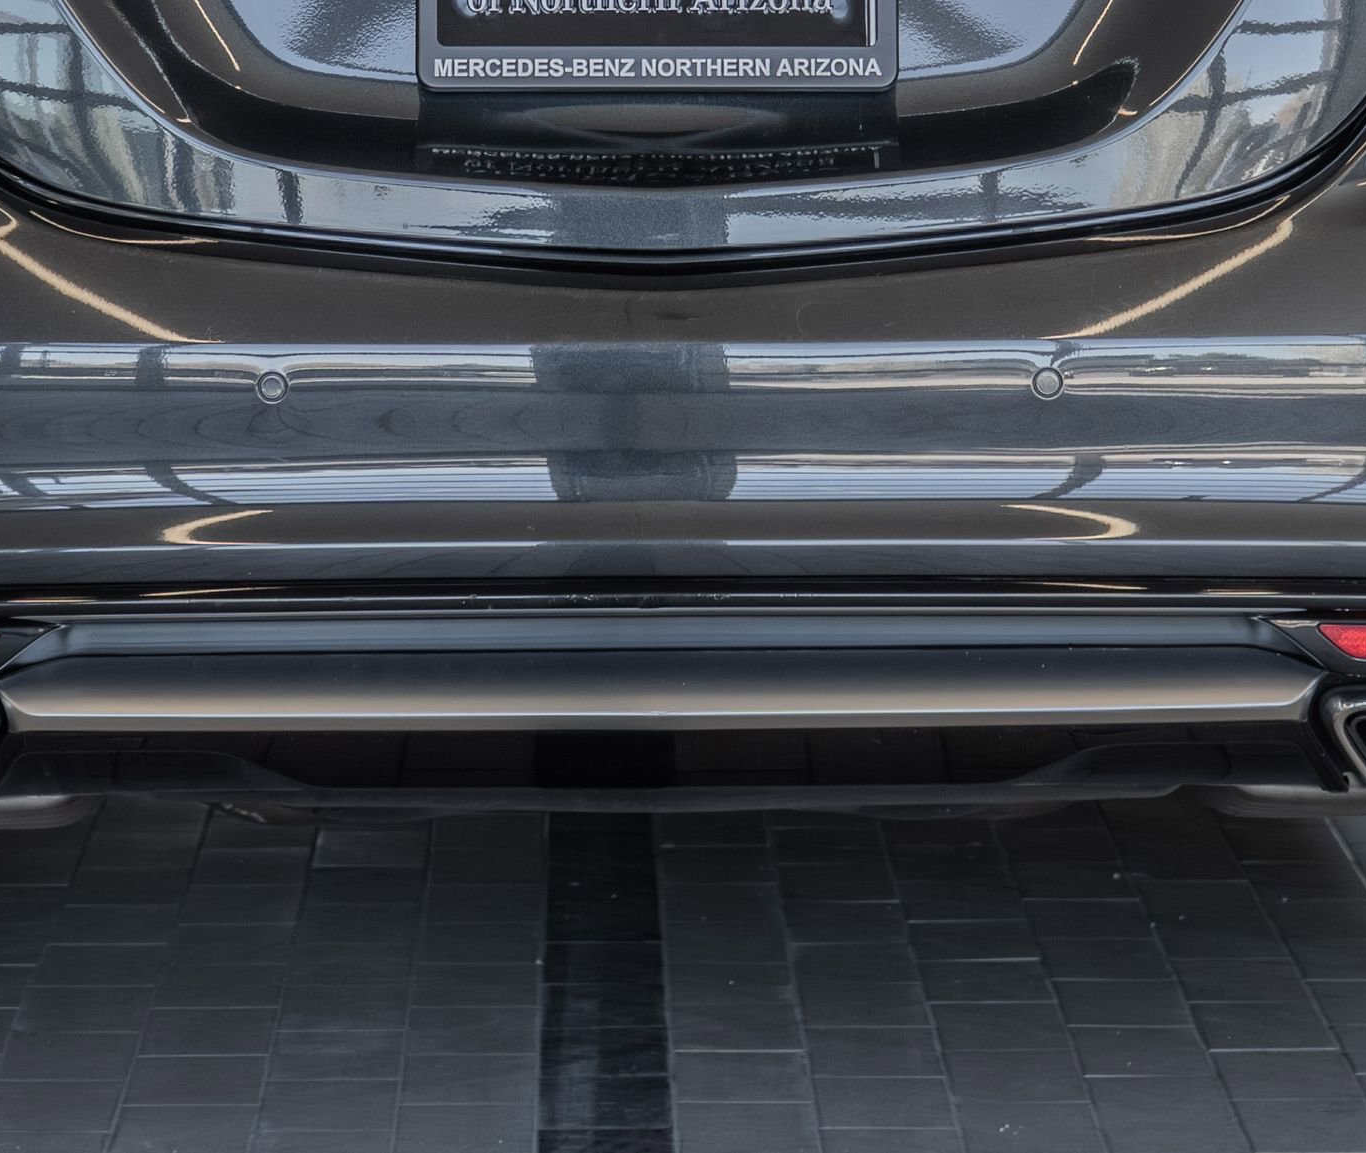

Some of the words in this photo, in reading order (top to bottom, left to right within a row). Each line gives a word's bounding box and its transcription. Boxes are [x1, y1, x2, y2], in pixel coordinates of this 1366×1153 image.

[434, 58, 635, 78] MERCEDES-BENZ
[641, 58, 771, 77] NORTHERN
[776, 58, 883, 77] ARIZONA
